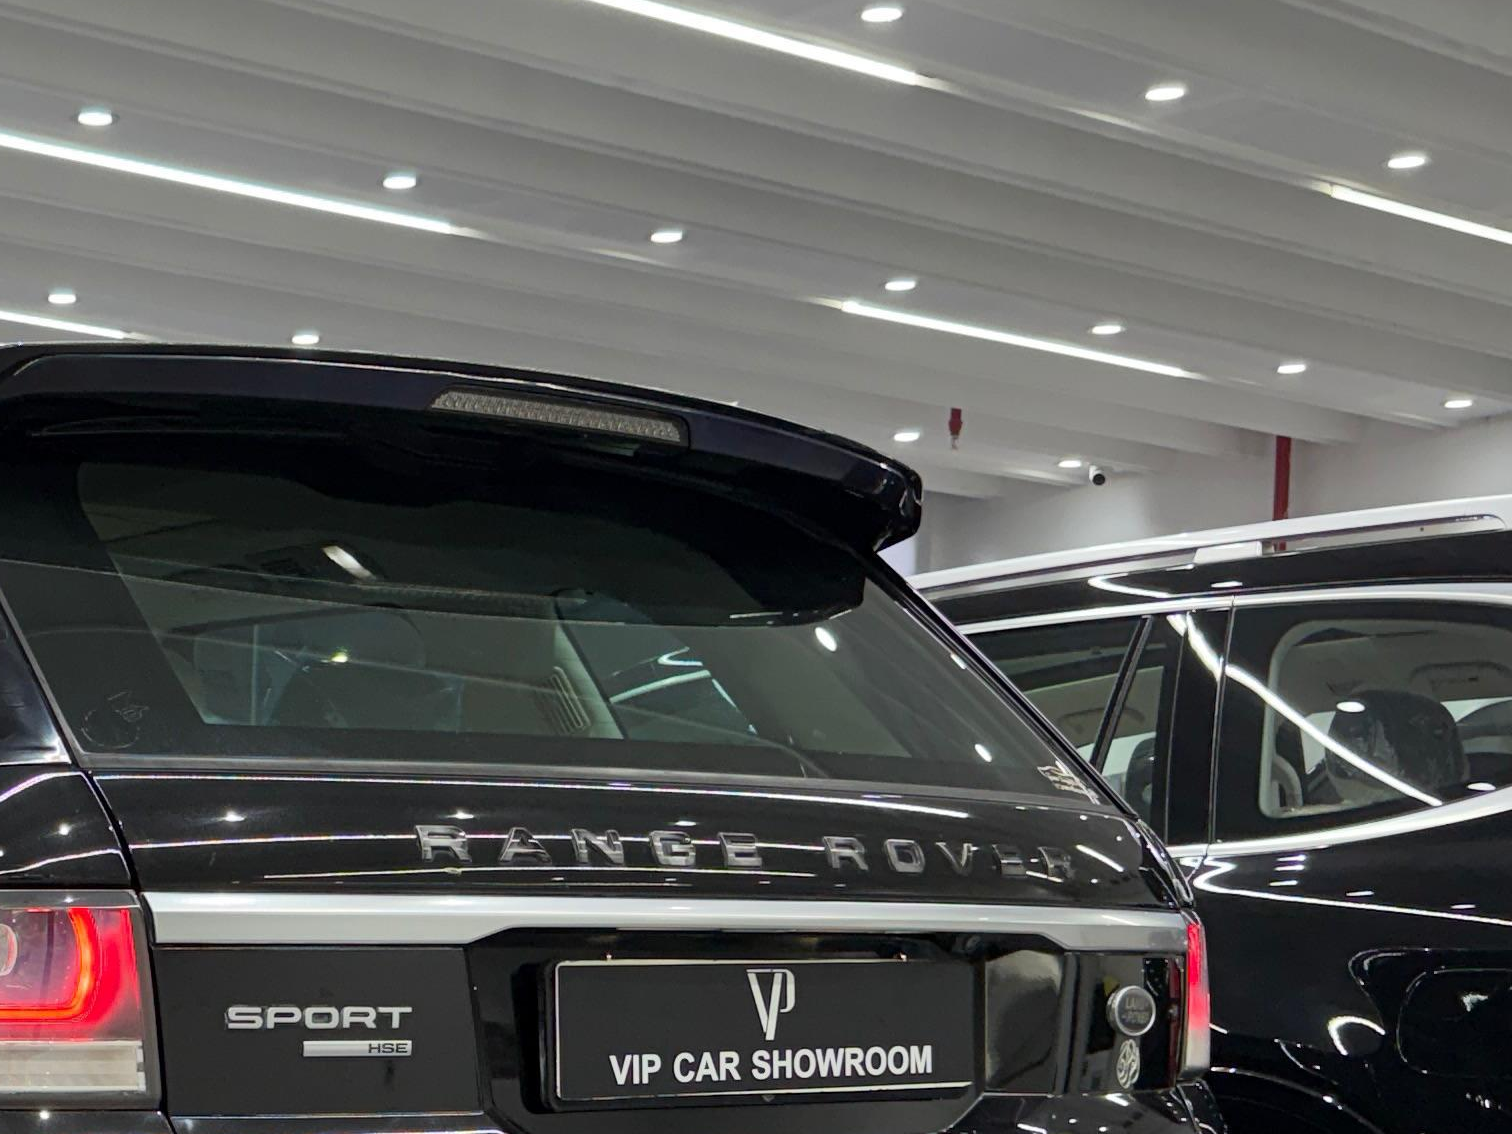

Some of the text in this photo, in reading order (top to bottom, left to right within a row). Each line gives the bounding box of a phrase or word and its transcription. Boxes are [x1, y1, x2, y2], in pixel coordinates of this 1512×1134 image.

[414, 824, 1076, 880] RANGE ROVER
[226, 1006, 413, 1030] SPORT
[368, 1042, 408, 1054] HSE
[608, 1045, 933, 1086] VIP CAR SHOWROOM
